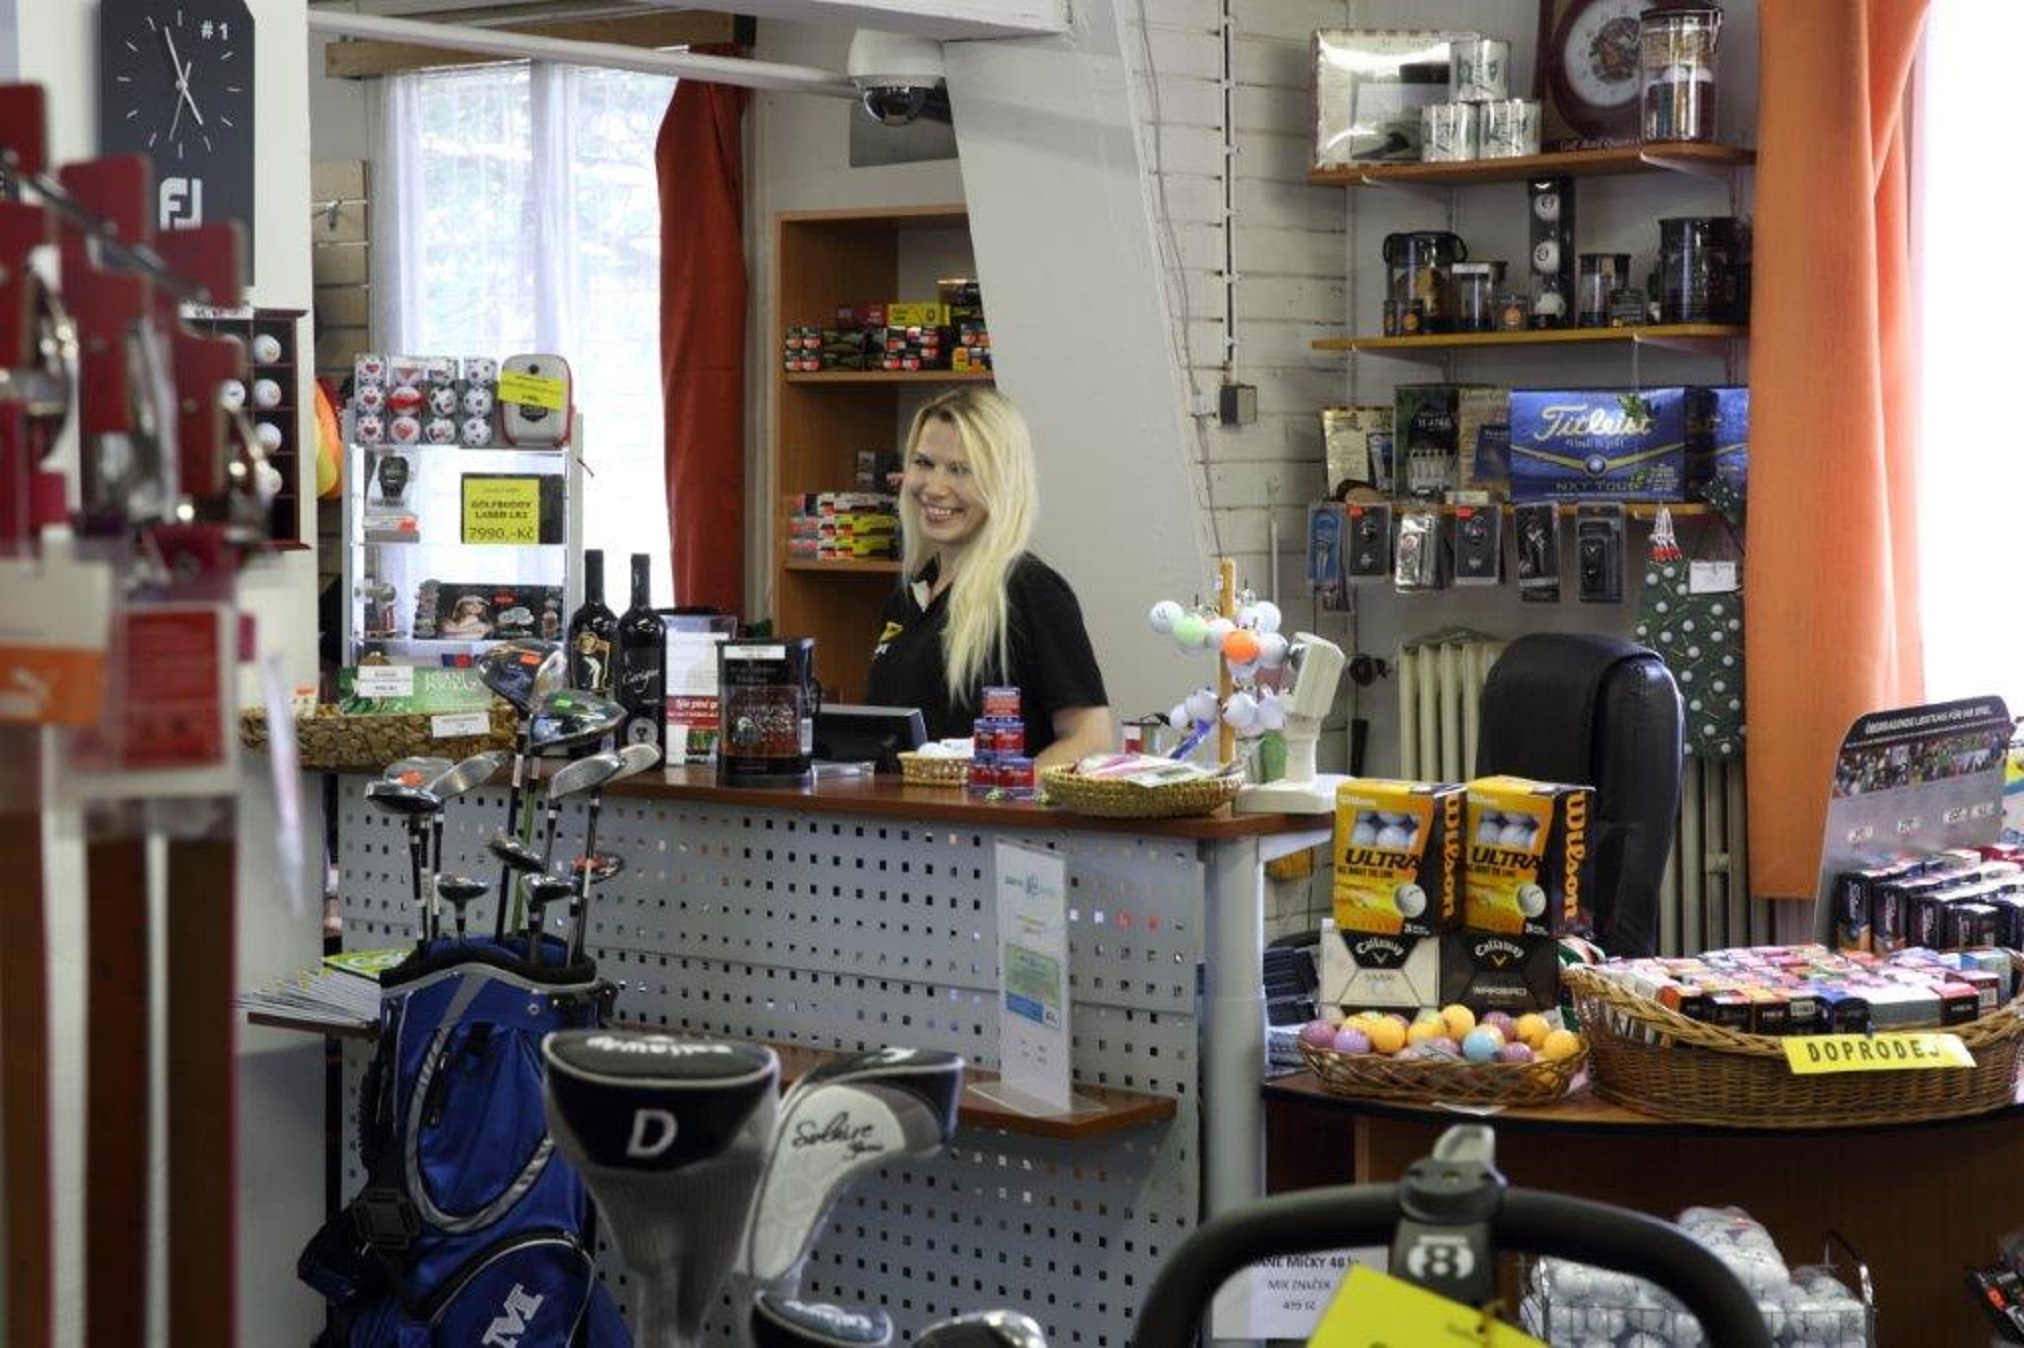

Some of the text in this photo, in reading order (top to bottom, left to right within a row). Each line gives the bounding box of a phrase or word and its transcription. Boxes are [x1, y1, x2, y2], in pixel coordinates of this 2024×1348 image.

[1533, 403, 1655, 441] Titleist
[1345, 848, 1421, 870] ULTRA
[1472, 847, 1543, 870] ULTRA
[1565, 791, 1585, 921] Wilson
[1355, 936, 1404, 956] Callaway
[1474, 938, 1525, 959] Callaway
[1806, 1039, 1940, 1063] DOPRODEJ
[626, 1108, 678, 1158] D
